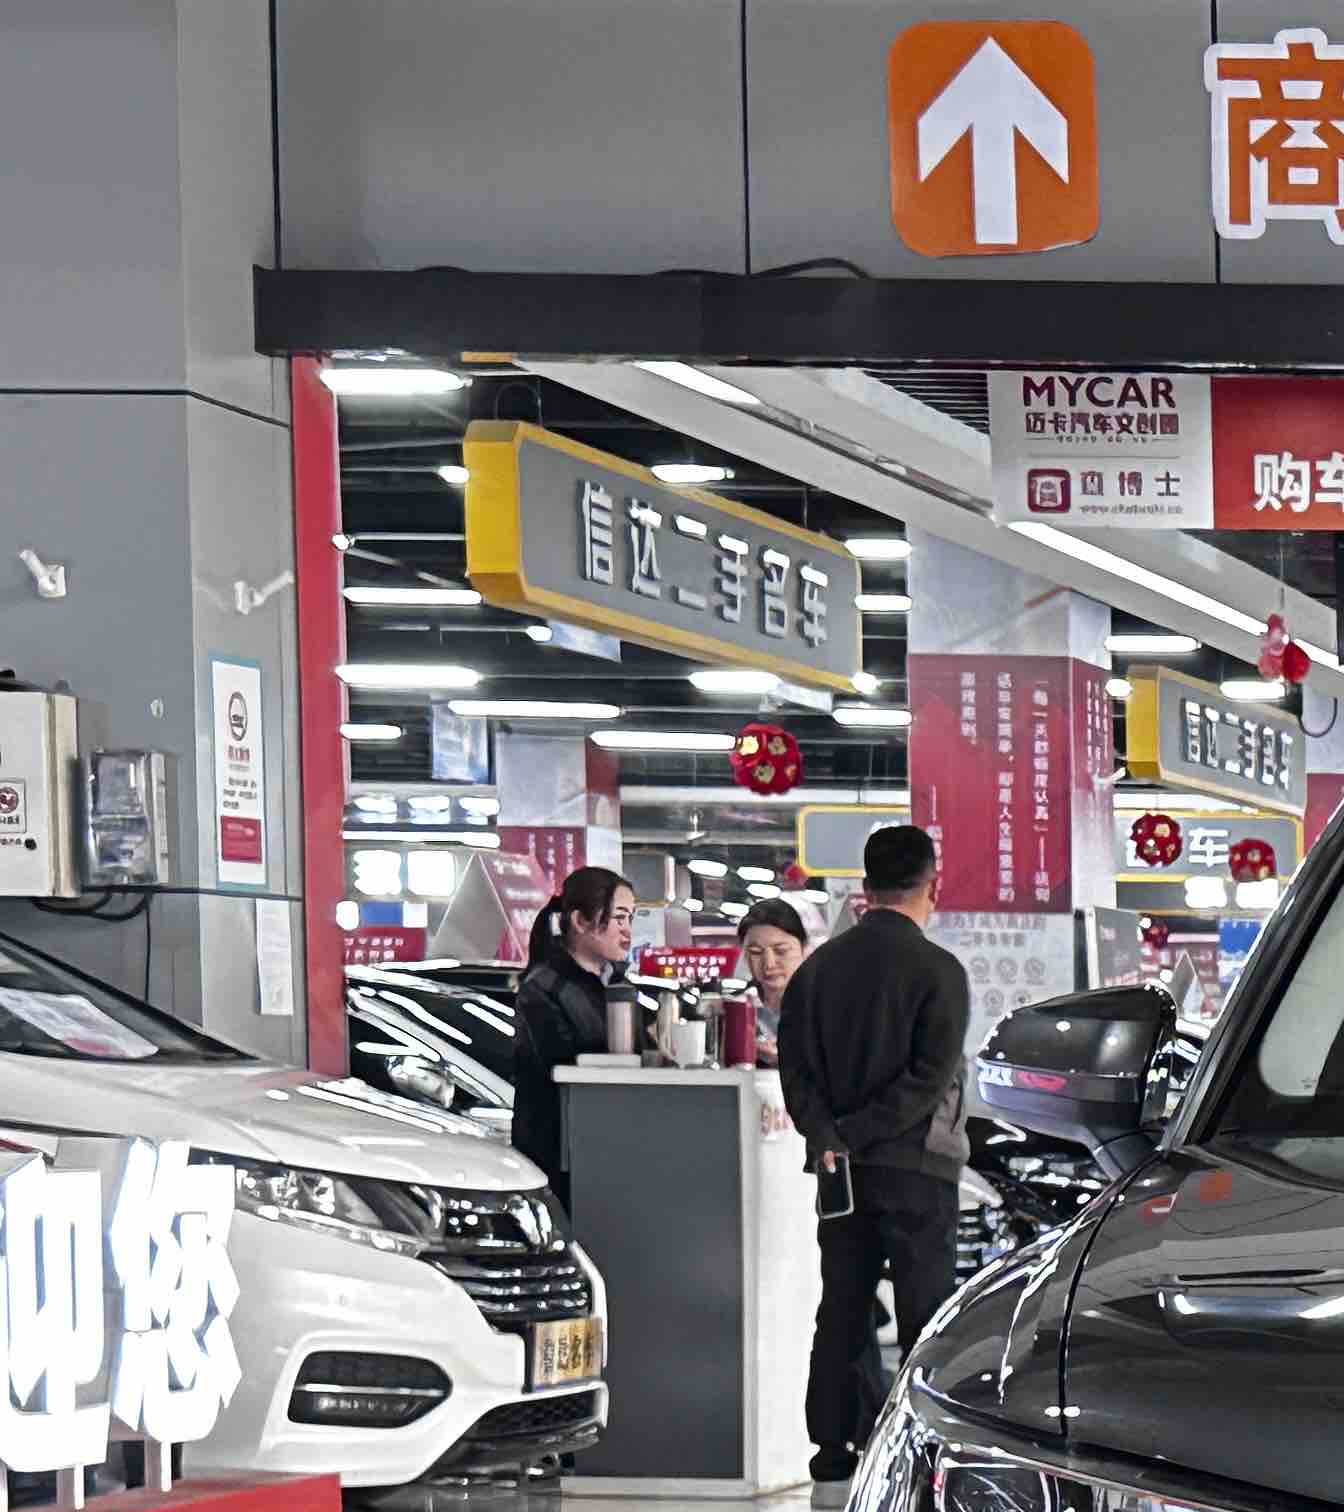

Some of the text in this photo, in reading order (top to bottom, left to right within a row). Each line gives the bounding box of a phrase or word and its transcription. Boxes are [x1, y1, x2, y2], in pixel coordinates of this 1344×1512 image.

[1022, 376, 1176, 408] MYCAR
[1080, 471, 1181, 497] 查博士
[580, 478, 830, 649] 信达二手名车
